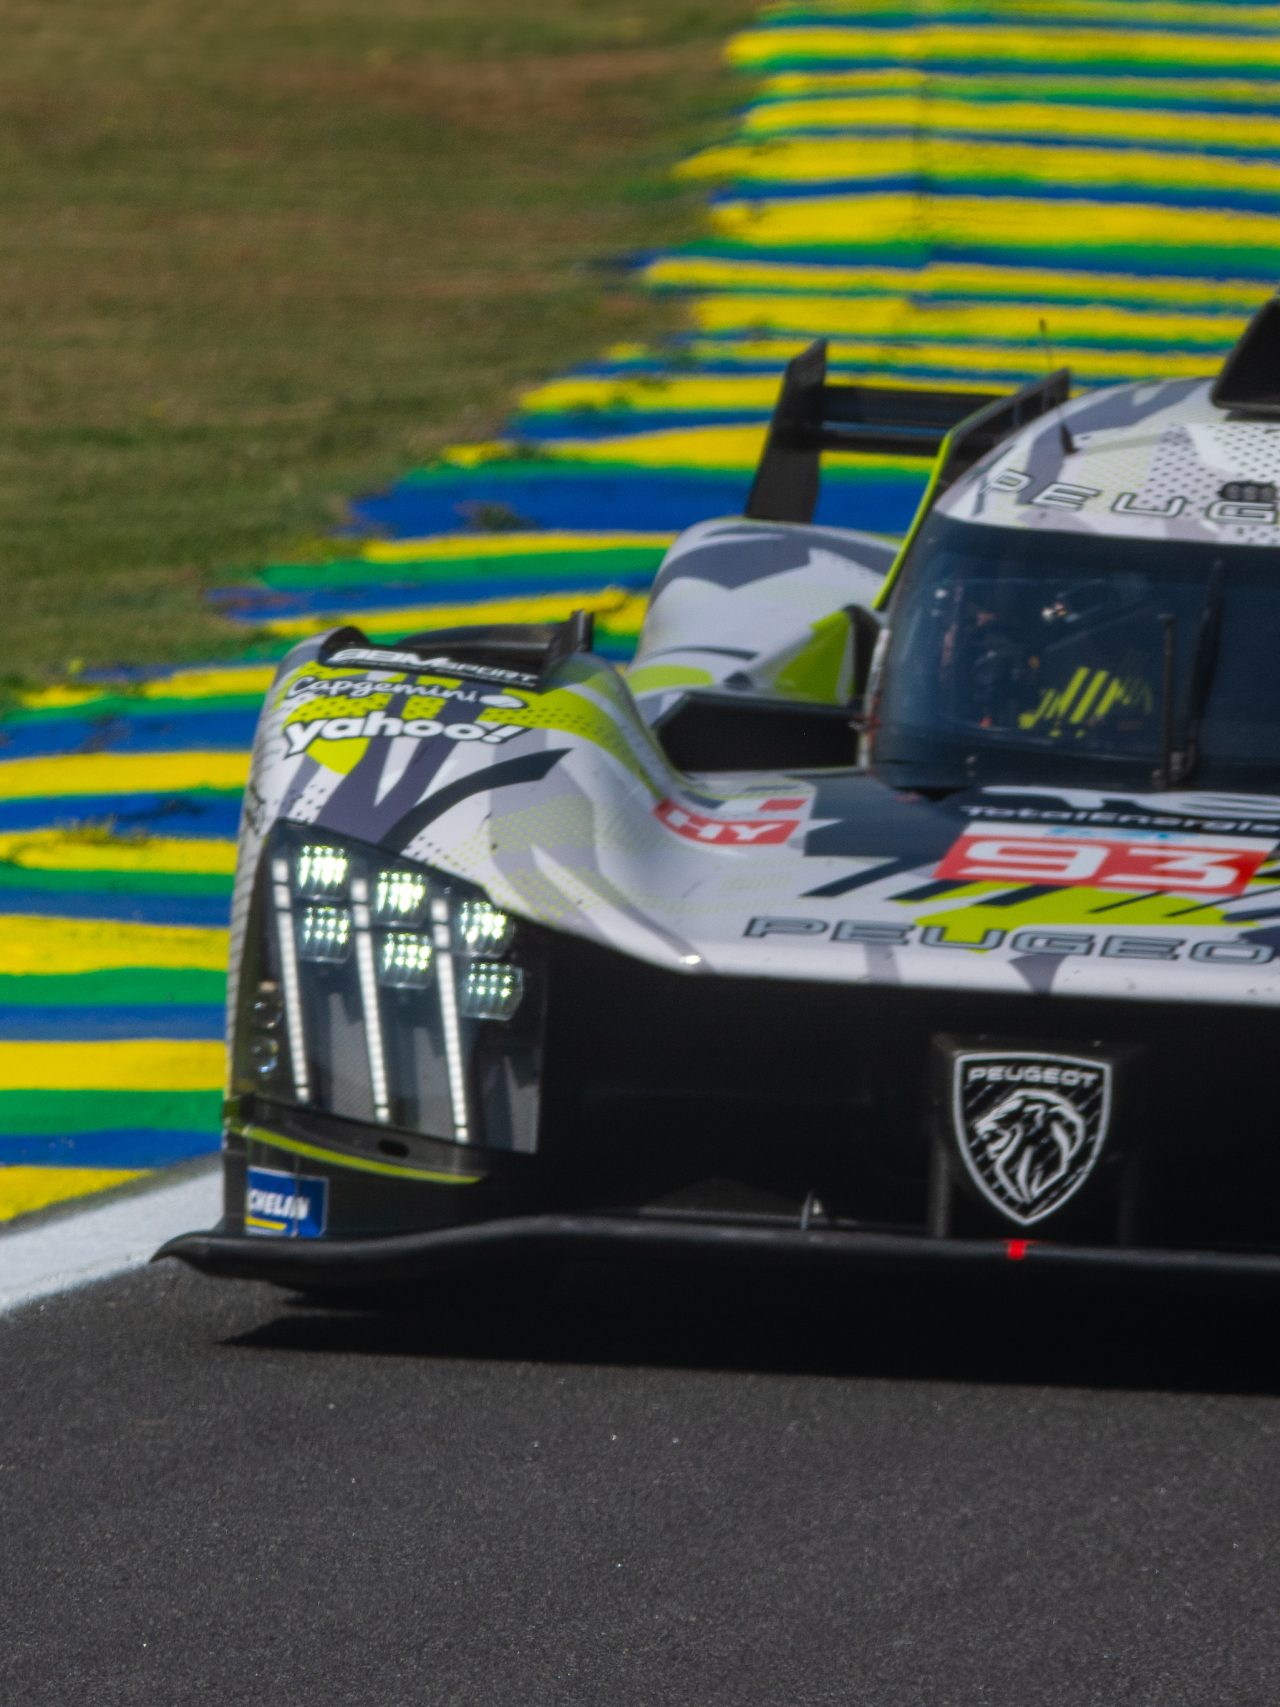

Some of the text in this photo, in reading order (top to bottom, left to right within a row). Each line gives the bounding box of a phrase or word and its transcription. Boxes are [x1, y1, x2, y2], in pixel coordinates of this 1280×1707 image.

[287, 676, 480, 702] Capgemini
[285, 710, 531, 758] yahoo!
[956, 839, 1242, 889] 93
[969, 1065, 1098, 1087] PEUGEOT
